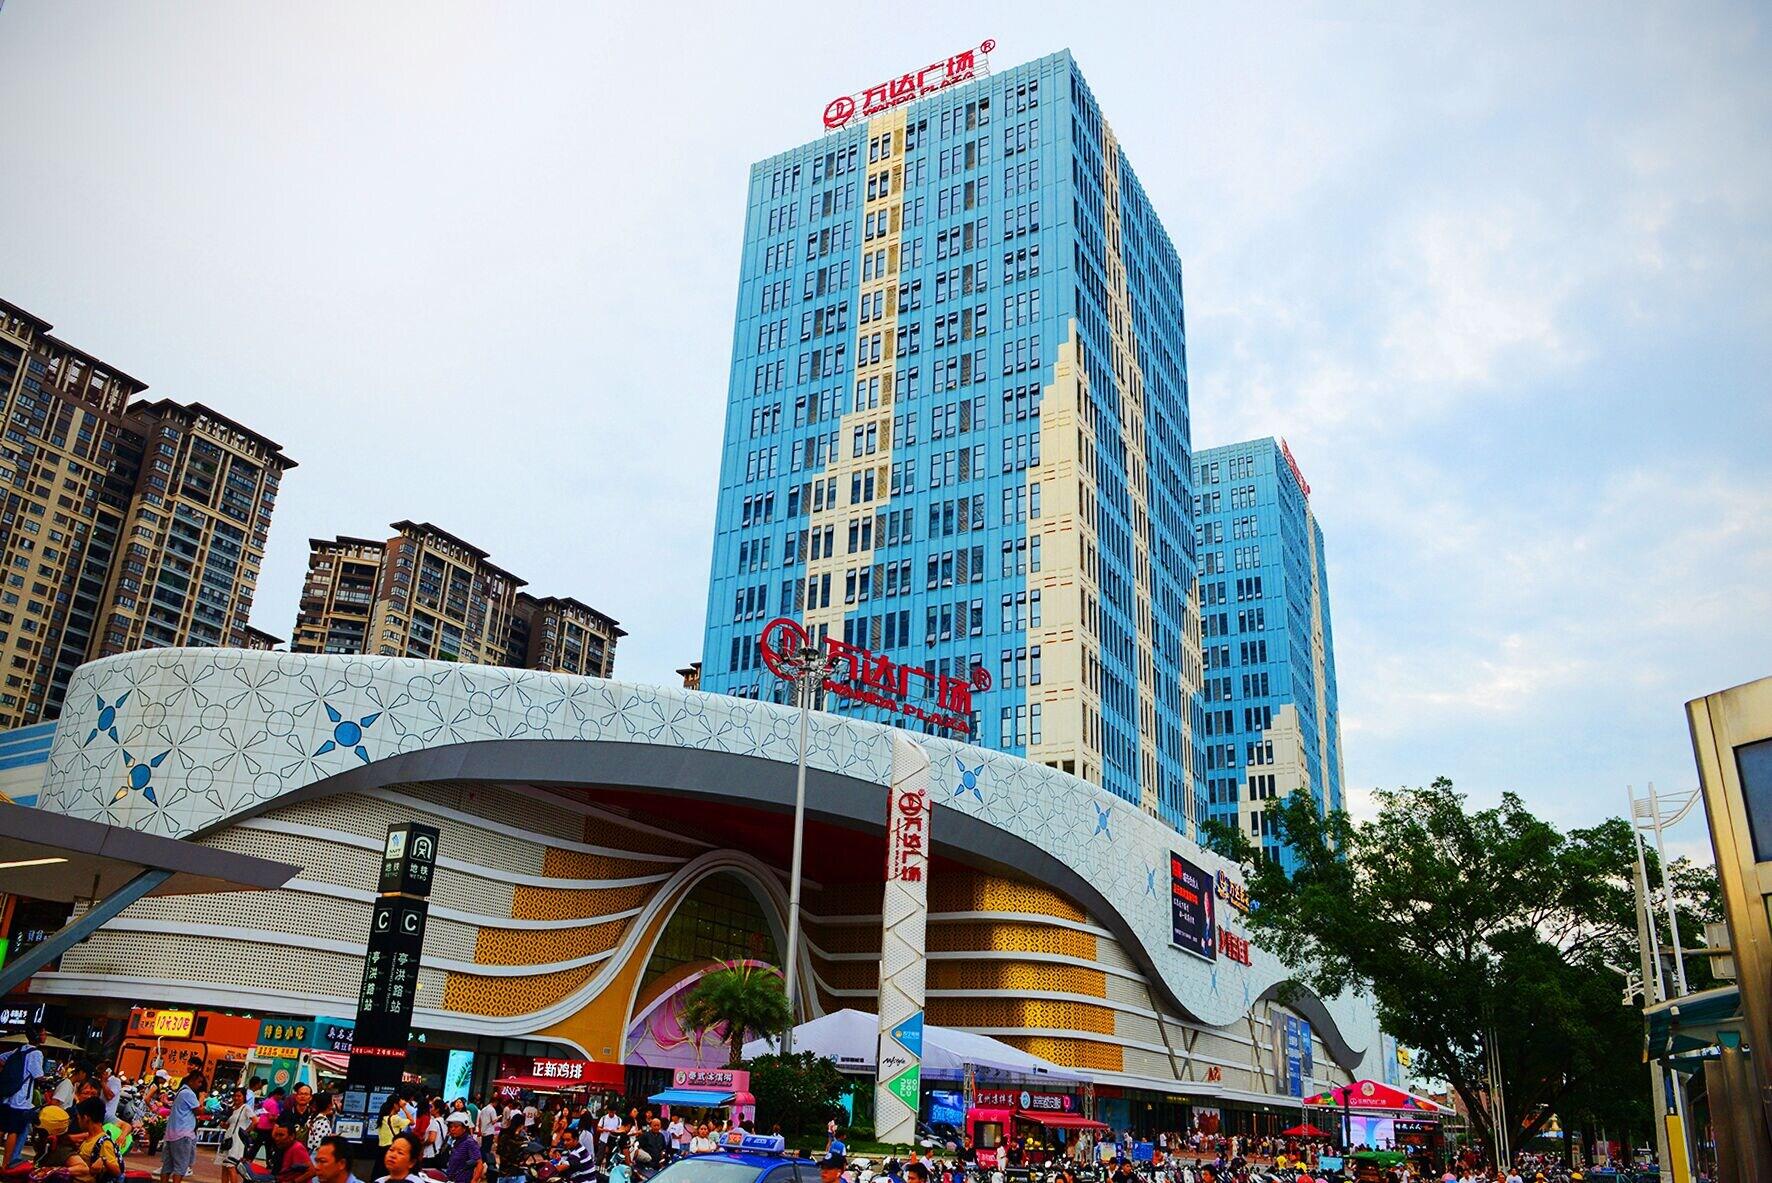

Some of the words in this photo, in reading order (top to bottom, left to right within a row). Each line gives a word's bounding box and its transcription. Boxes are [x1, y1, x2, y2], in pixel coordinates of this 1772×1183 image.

[862, 50, 975, 109] 万达广场
[863, 93, 916, 116] WANDA
[920, 71, 976, 95] PLAZA
[823, 636, 972, 716] 万达广场
[823, 680, 898, 712] WANDA
[903, 704, 971, 733] PLAZA
[410, 863, 428, 875] 地铁
[901, 816, 922, 881] 万达广场
[378, 911, 389, 929] C
[404, 914, 417, 931] C
[390, 952, 409, 1013] 亭洪路站
[264, 1024, 304, 1040] 特色小吃
[532, 1061, 583, 1079] 正新鸡排
